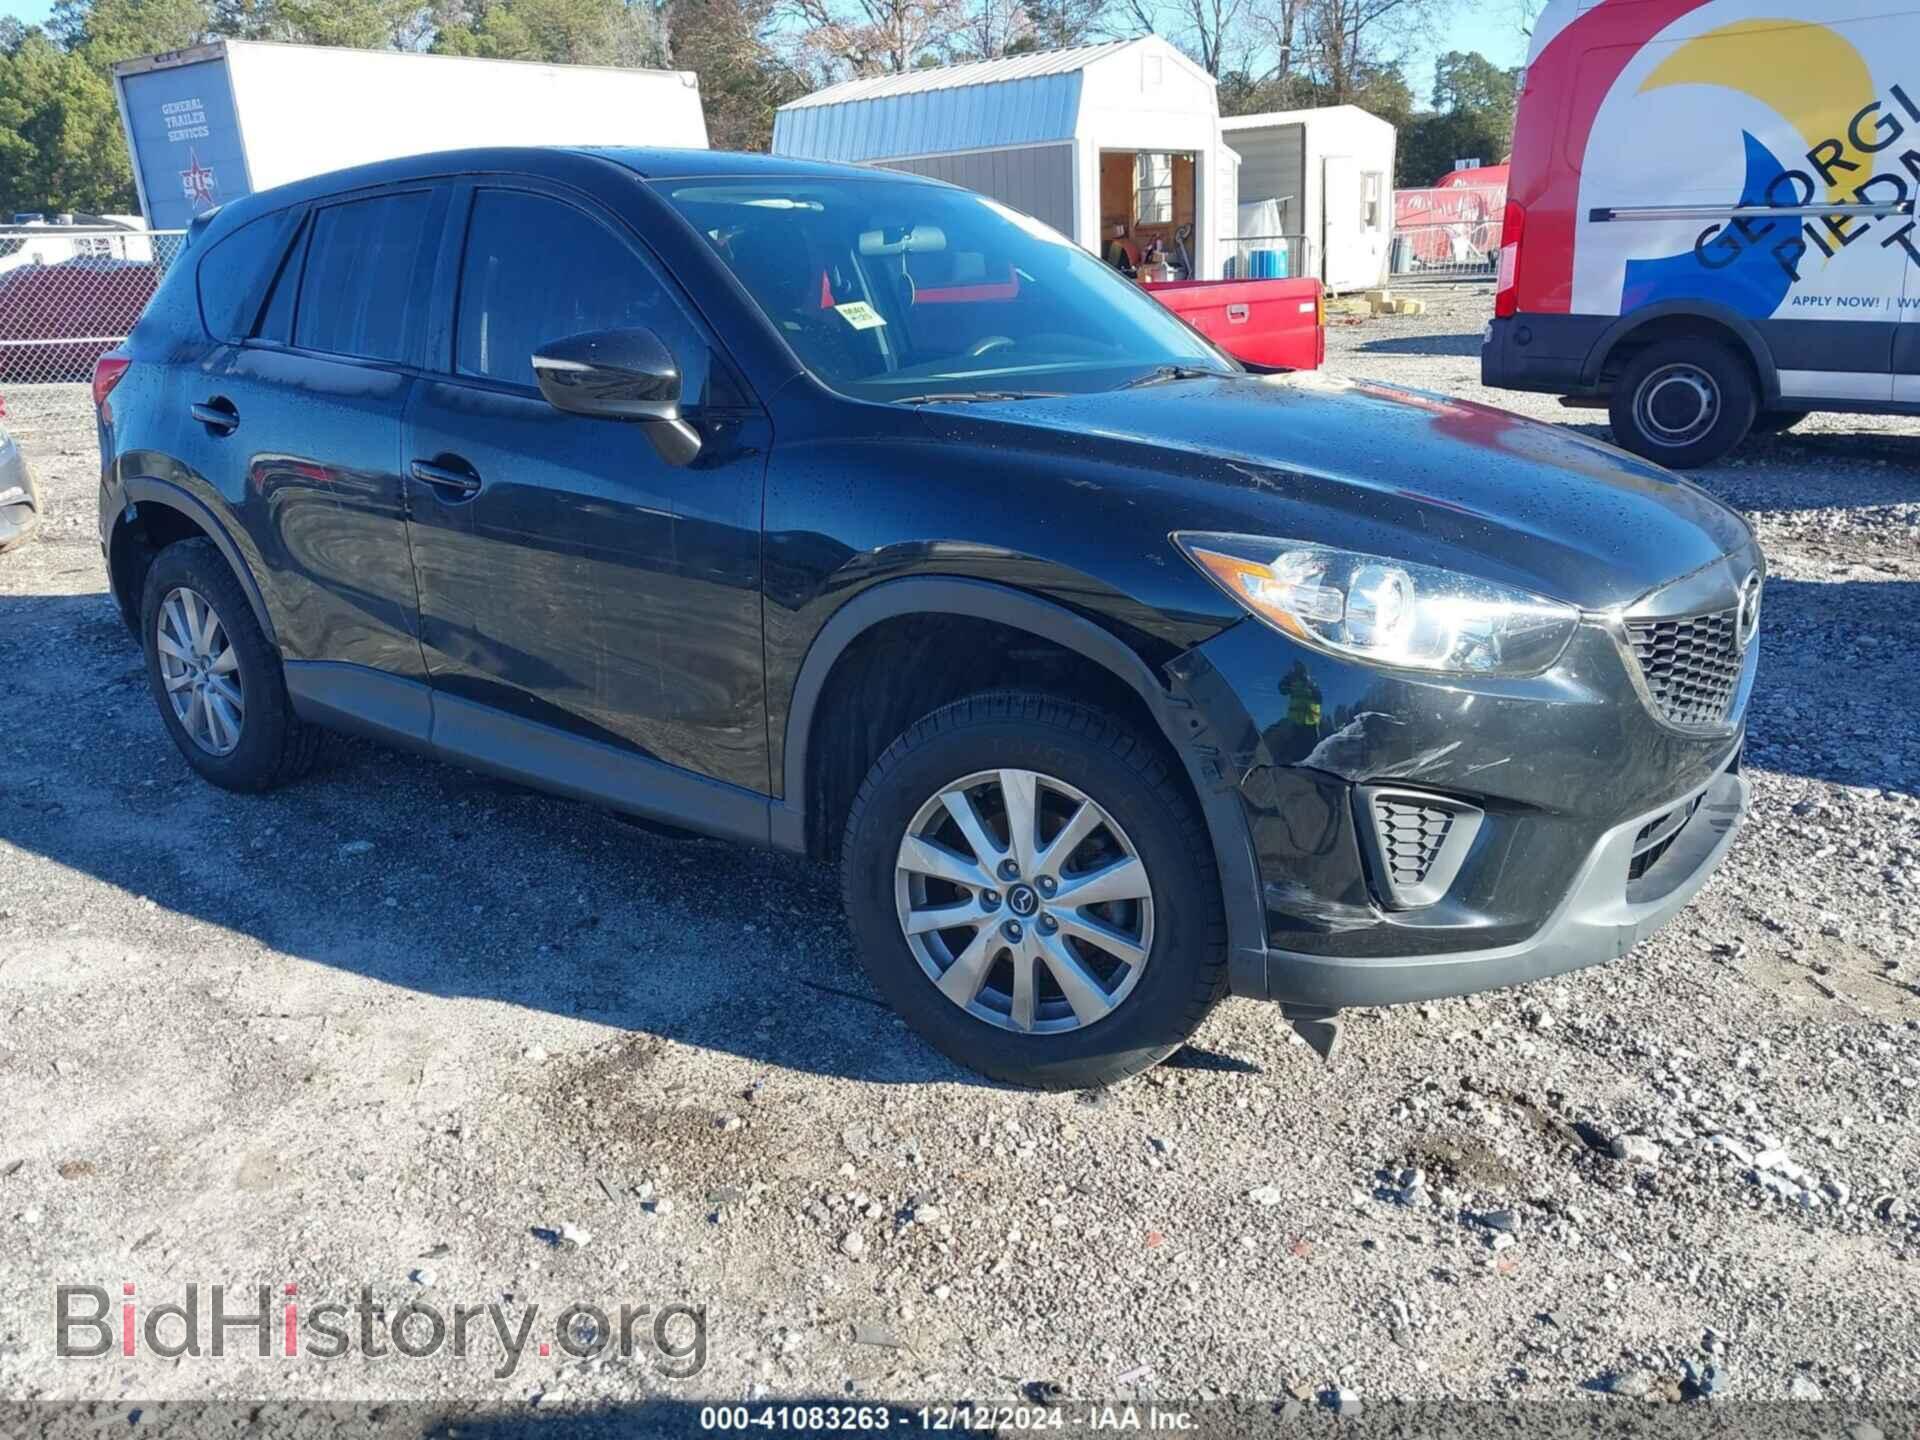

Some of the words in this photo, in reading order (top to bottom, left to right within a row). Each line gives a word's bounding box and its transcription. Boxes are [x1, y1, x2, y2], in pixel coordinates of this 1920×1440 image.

[162, 98, 203, 114] GENERAL
[164, 111, 206, 128] TRAILER
[167, 126, 209, 142] SERVICES
[1694, 84, 1920, 269] GEORGI
[1791, 295, 1832, 307] APPLY
[1836, 296, 1880, 308] NOW!
